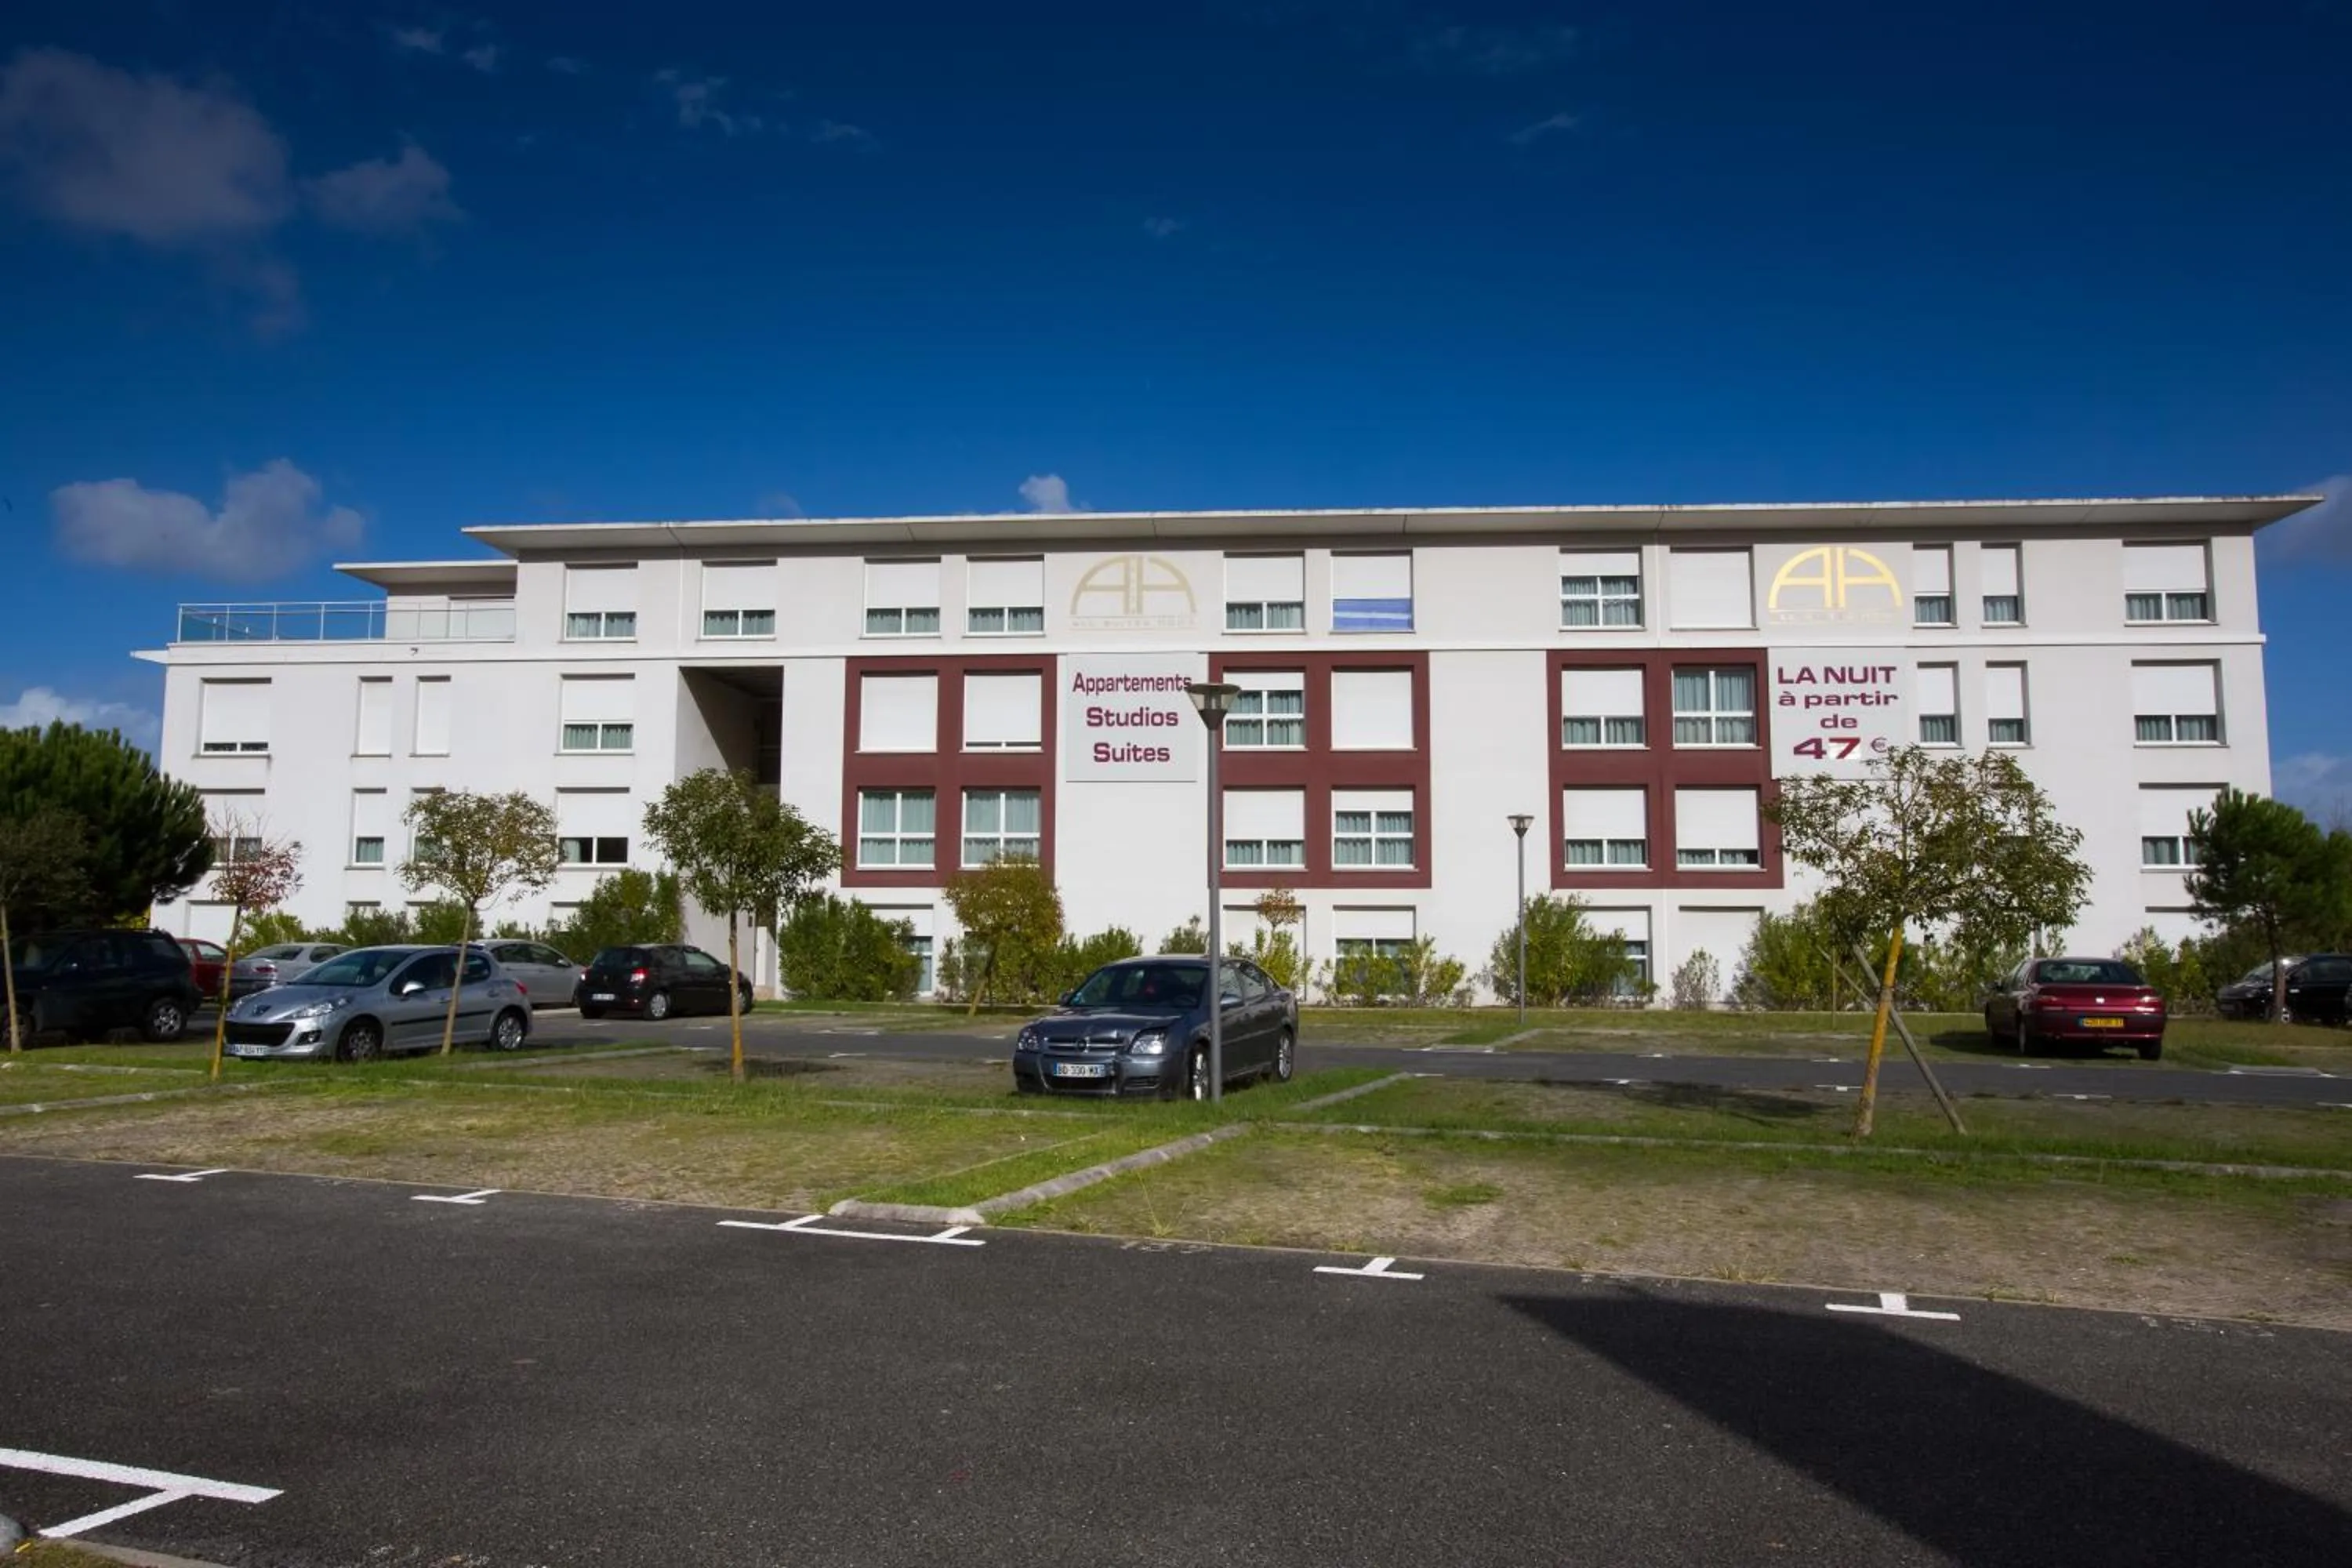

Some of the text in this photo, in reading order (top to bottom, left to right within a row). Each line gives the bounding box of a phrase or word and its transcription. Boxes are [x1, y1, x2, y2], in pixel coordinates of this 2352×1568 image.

[1073, 672, 1192, 695] Appartements
[1777, 666, 1897, 684] LA NUIT
[1778, 691, 1899, 710] à partir
[1087, 706, 1178, 727] Studios
[1820, 713, 1858, 729] de
[1093, 742, 1170, 763] Suites
[1793, 737, 1860, 760] 47
